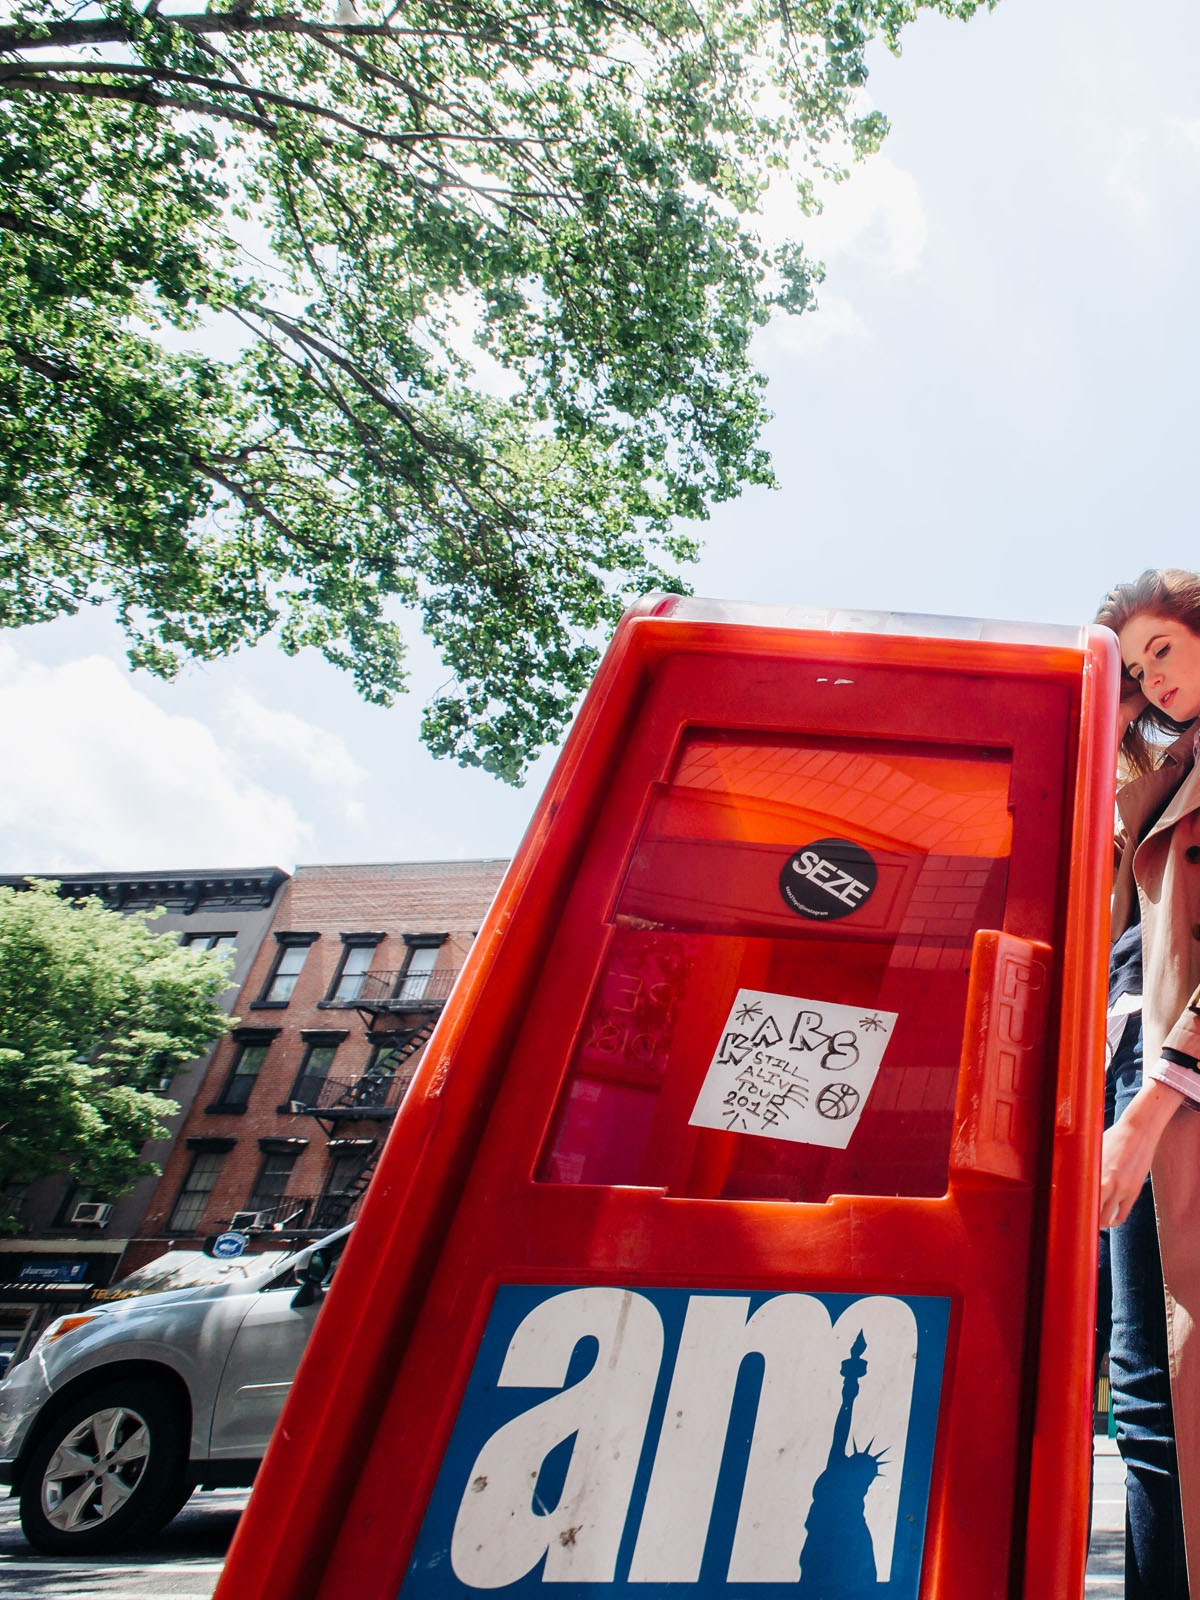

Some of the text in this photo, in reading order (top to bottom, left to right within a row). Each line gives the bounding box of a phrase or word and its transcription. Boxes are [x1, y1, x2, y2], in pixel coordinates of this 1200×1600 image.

[792, 851, 870, 908] SEZE
[735, 1065, 809, 1109] ALIVE
[752, 1051, 809, 1082] STILL
[722, 1090, 779, 1130] 2017
[736, 1078, 790, 1120] TOUR
[450, 1287, 918, 1589] am
